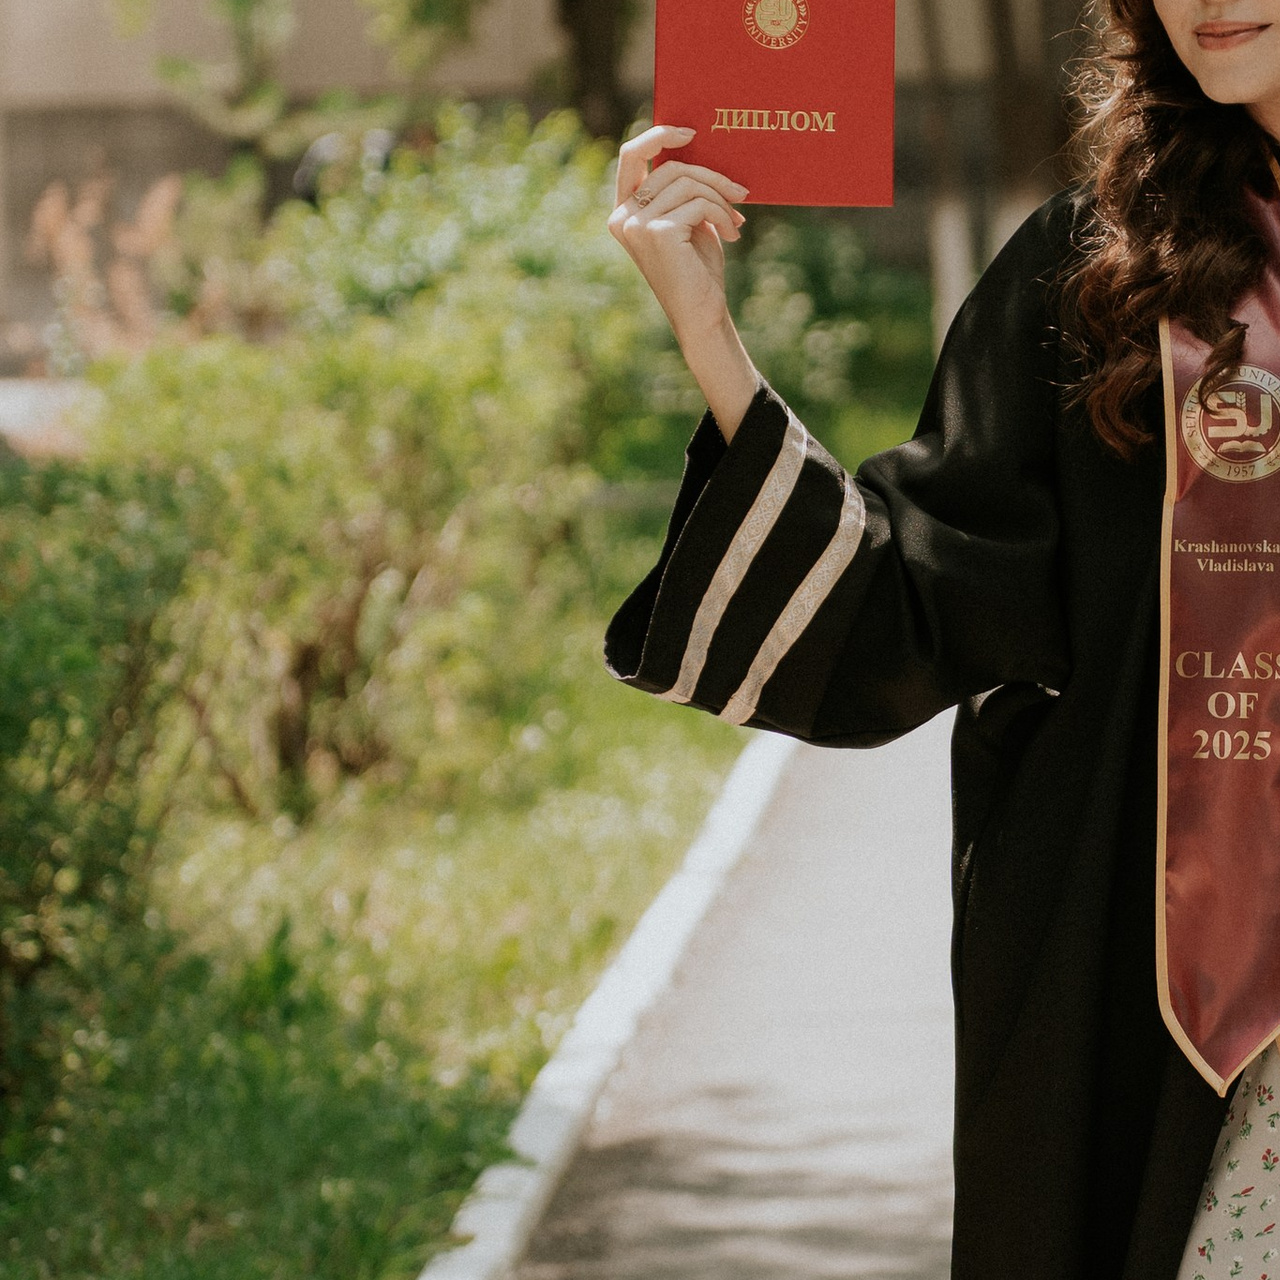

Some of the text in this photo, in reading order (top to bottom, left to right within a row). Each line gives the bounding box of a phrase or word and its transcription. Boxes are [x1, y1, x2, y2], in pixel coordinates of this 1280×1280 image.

[744, 17, 807, 47] UNIVERSITY
[711, 108, 836, 133] ДИПЛОМ
[1227, 464, 1255, 477] 1957
[1197, 558, 1274, 572] Vladislava
[1207, 691, 1259, 719] OF
[1192, 729, 1271, 760] 2025
